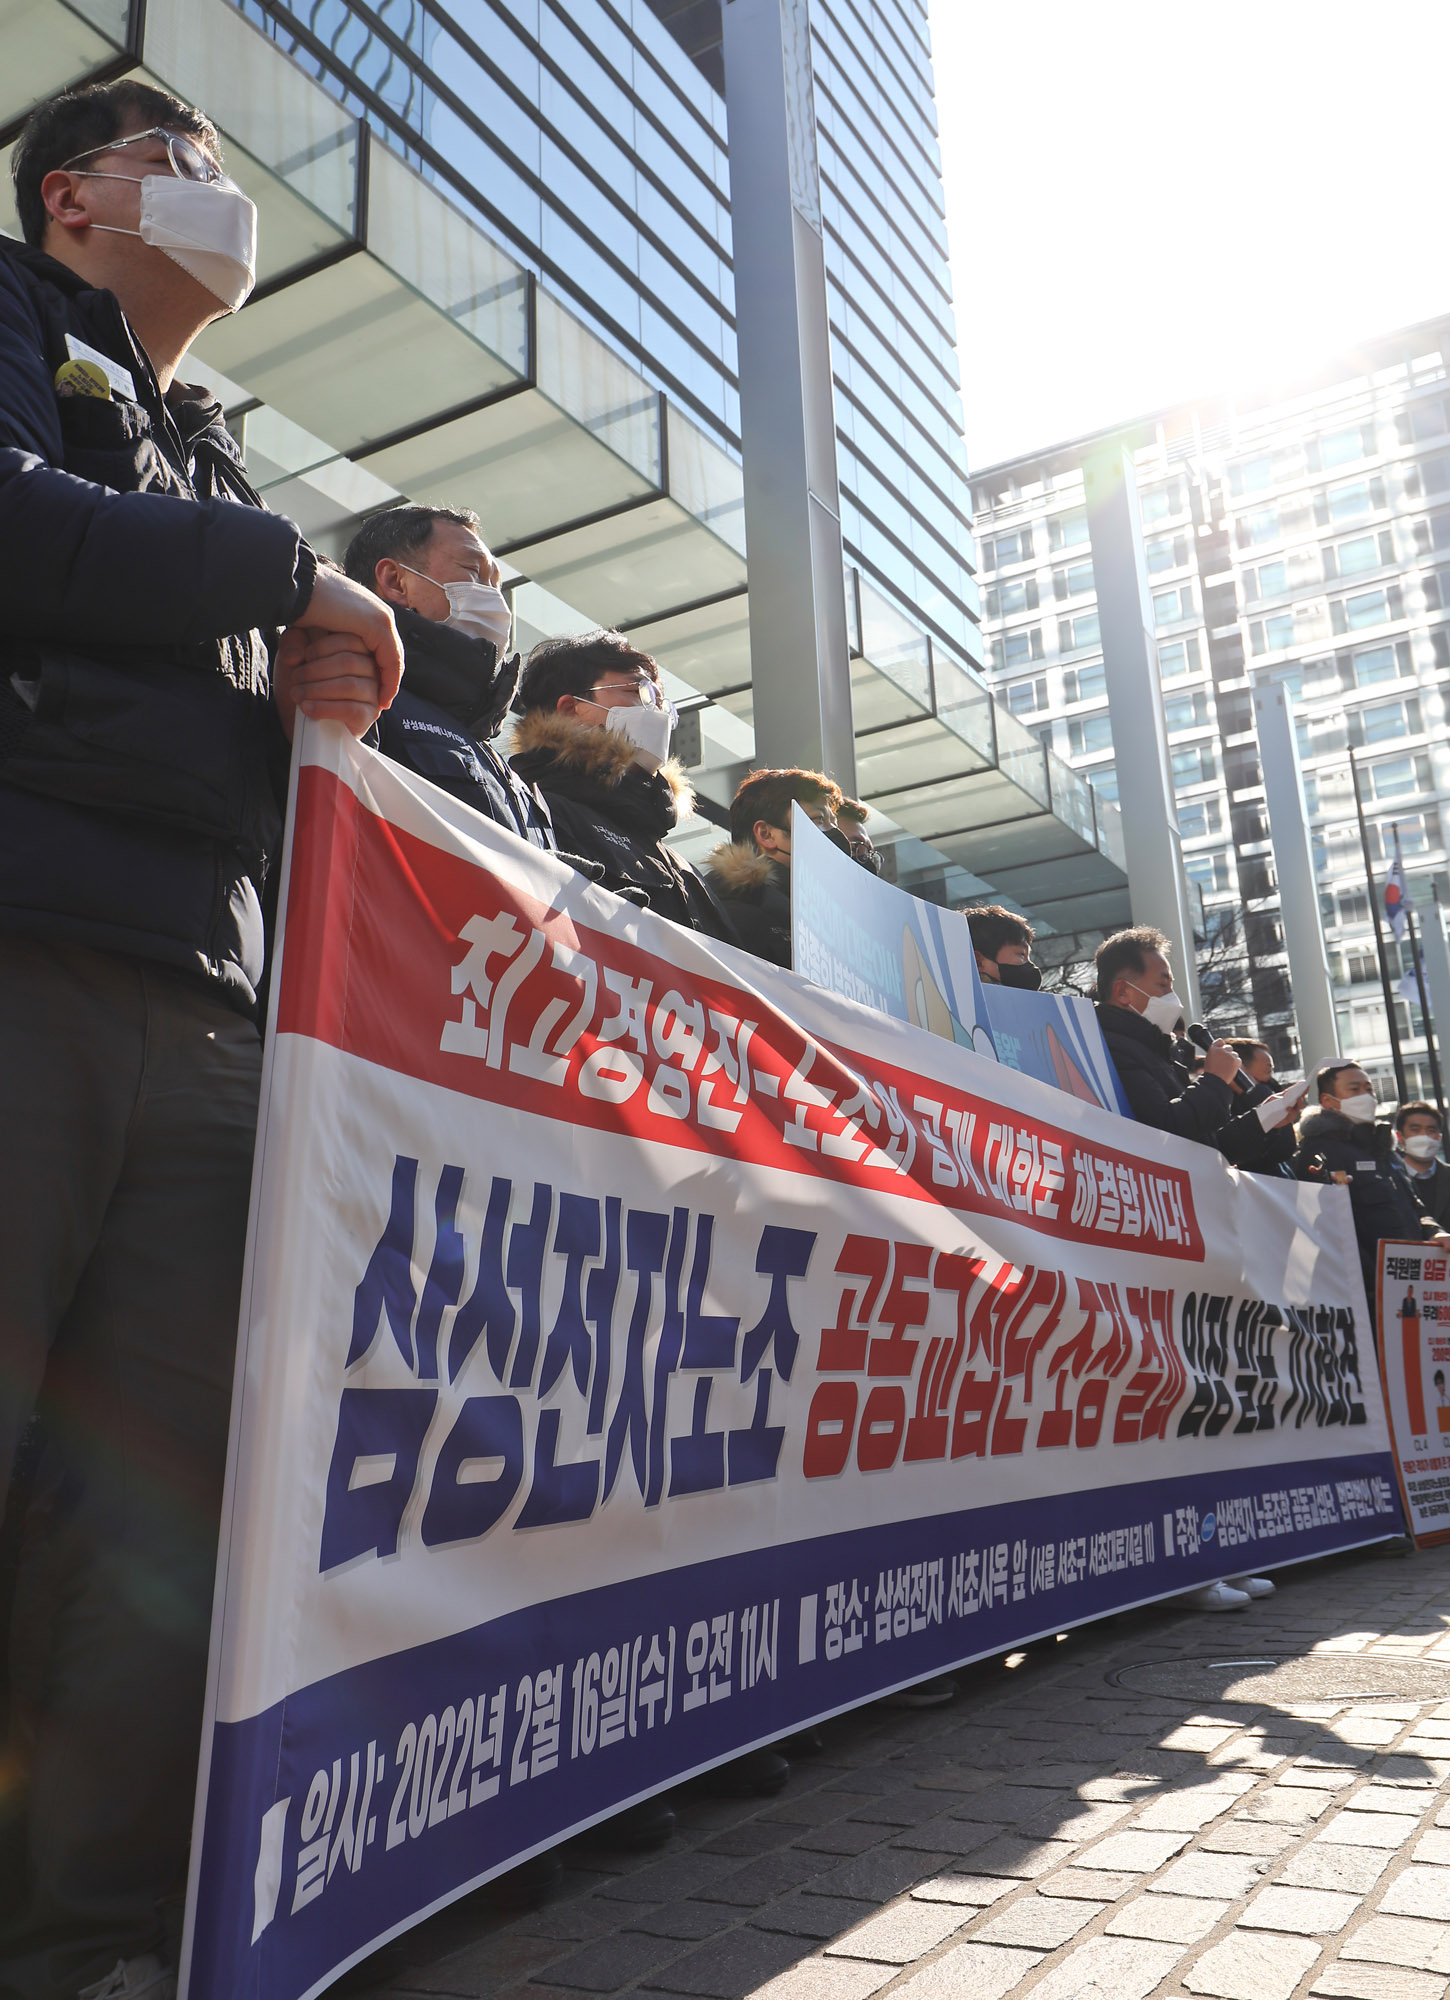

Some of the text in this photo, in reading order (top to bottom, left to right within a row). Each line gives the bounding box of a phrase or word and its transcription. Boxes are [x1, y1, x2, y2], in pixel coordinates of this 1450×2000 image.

[913, 1095, 984, 1197] 공개
[984, 1122, 1066, 1220] 대화로
[1071, 1149, 1191, 1246] 해결합시다!
[1424, 1258, 1447, 1281] 임금
[319, 1154, 818, 1573] 삼성전자노조
[803, 1233, 1066, 1478] 공동교섭단
[1176, 1291, 1233, 1439] 입장
[1233, 1299, 1283, 1433] 발표
[1281, 1304, 1367, 1430] 기자회견
[1216, 1496, 1257, 1548] 삼성전자
[1253, 1489, 1294, 1539] 노동조합
[824, 1578, 870, 1662] 장소:
[874, 1557, 944, 1644] 삼성전자
[948, 1543, 1008, 1619] 서초사옥
[1012, 1539, 1028, 1602] 앞
[1030, 1543, 1055, 1595] (서울
[1058, 1537, 1087, 1584] 서초구
[1089, 1524, 1144, 1576] 서초대로74길
[290, 1598, 780, 1916] 일시: 2022년 2월 16일(수) 오전 11시
